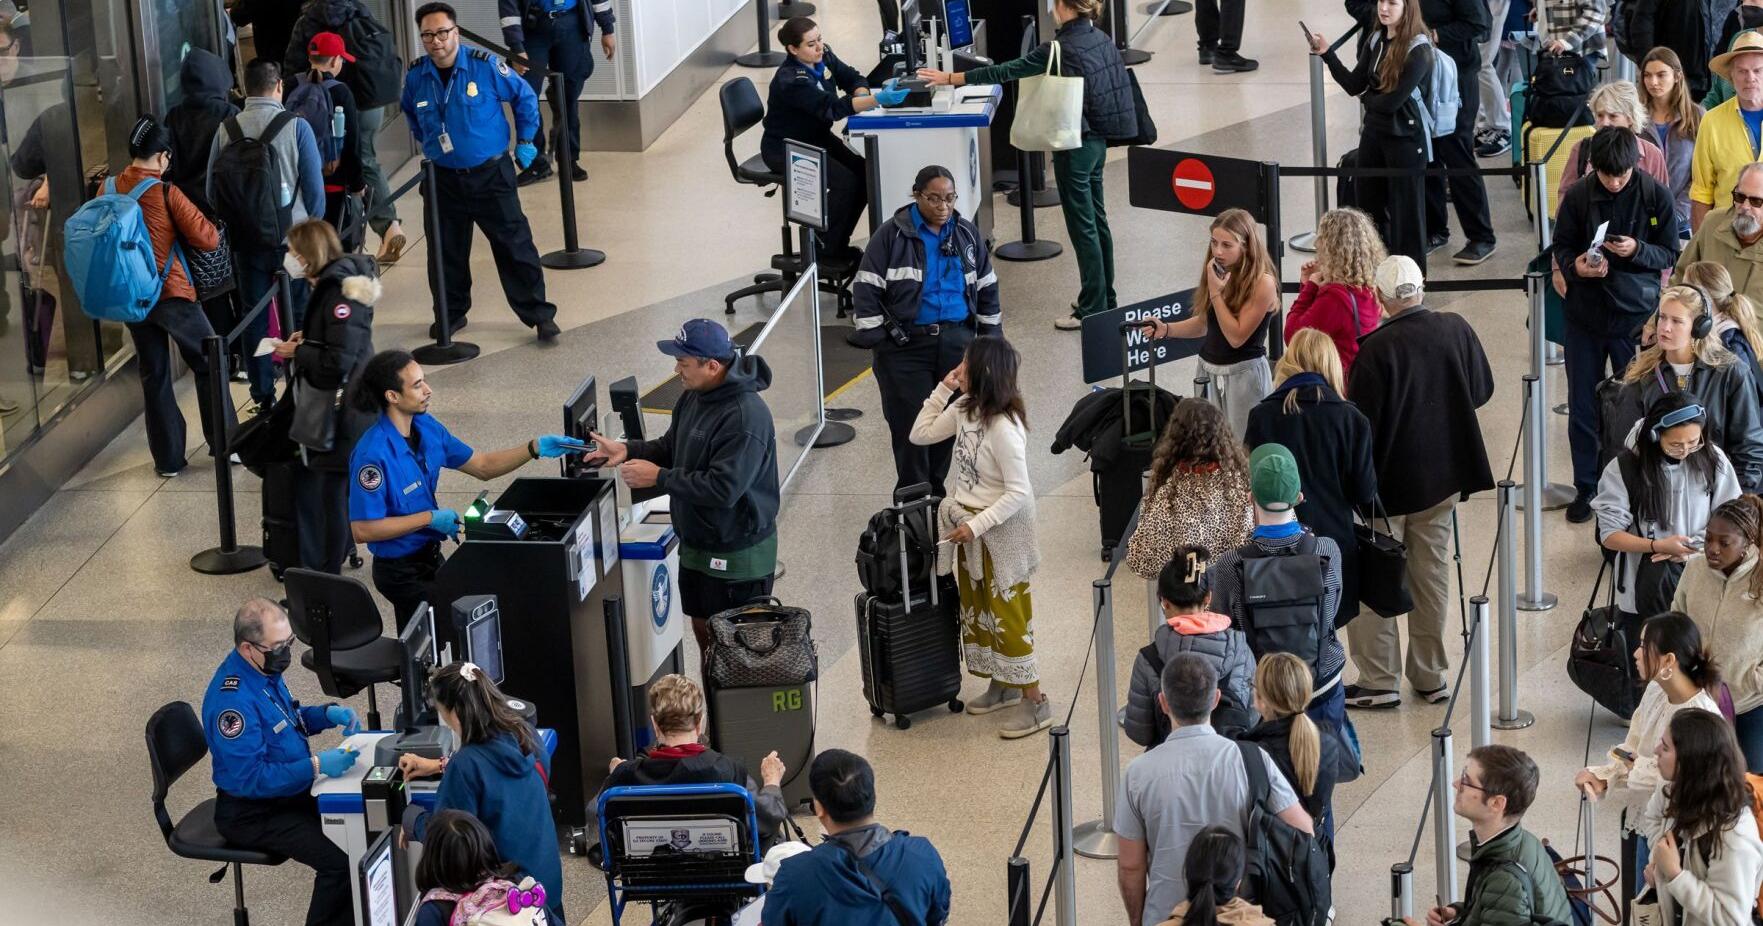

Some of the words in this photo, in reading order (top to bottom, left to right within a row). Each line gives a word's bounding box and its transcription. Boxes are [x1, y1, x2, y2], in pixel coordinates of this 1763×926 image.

[1125, 302, 1181, 321] Please
[1127, 345, 1167, 367] Hee
[772, 690, 802, 712] RG
